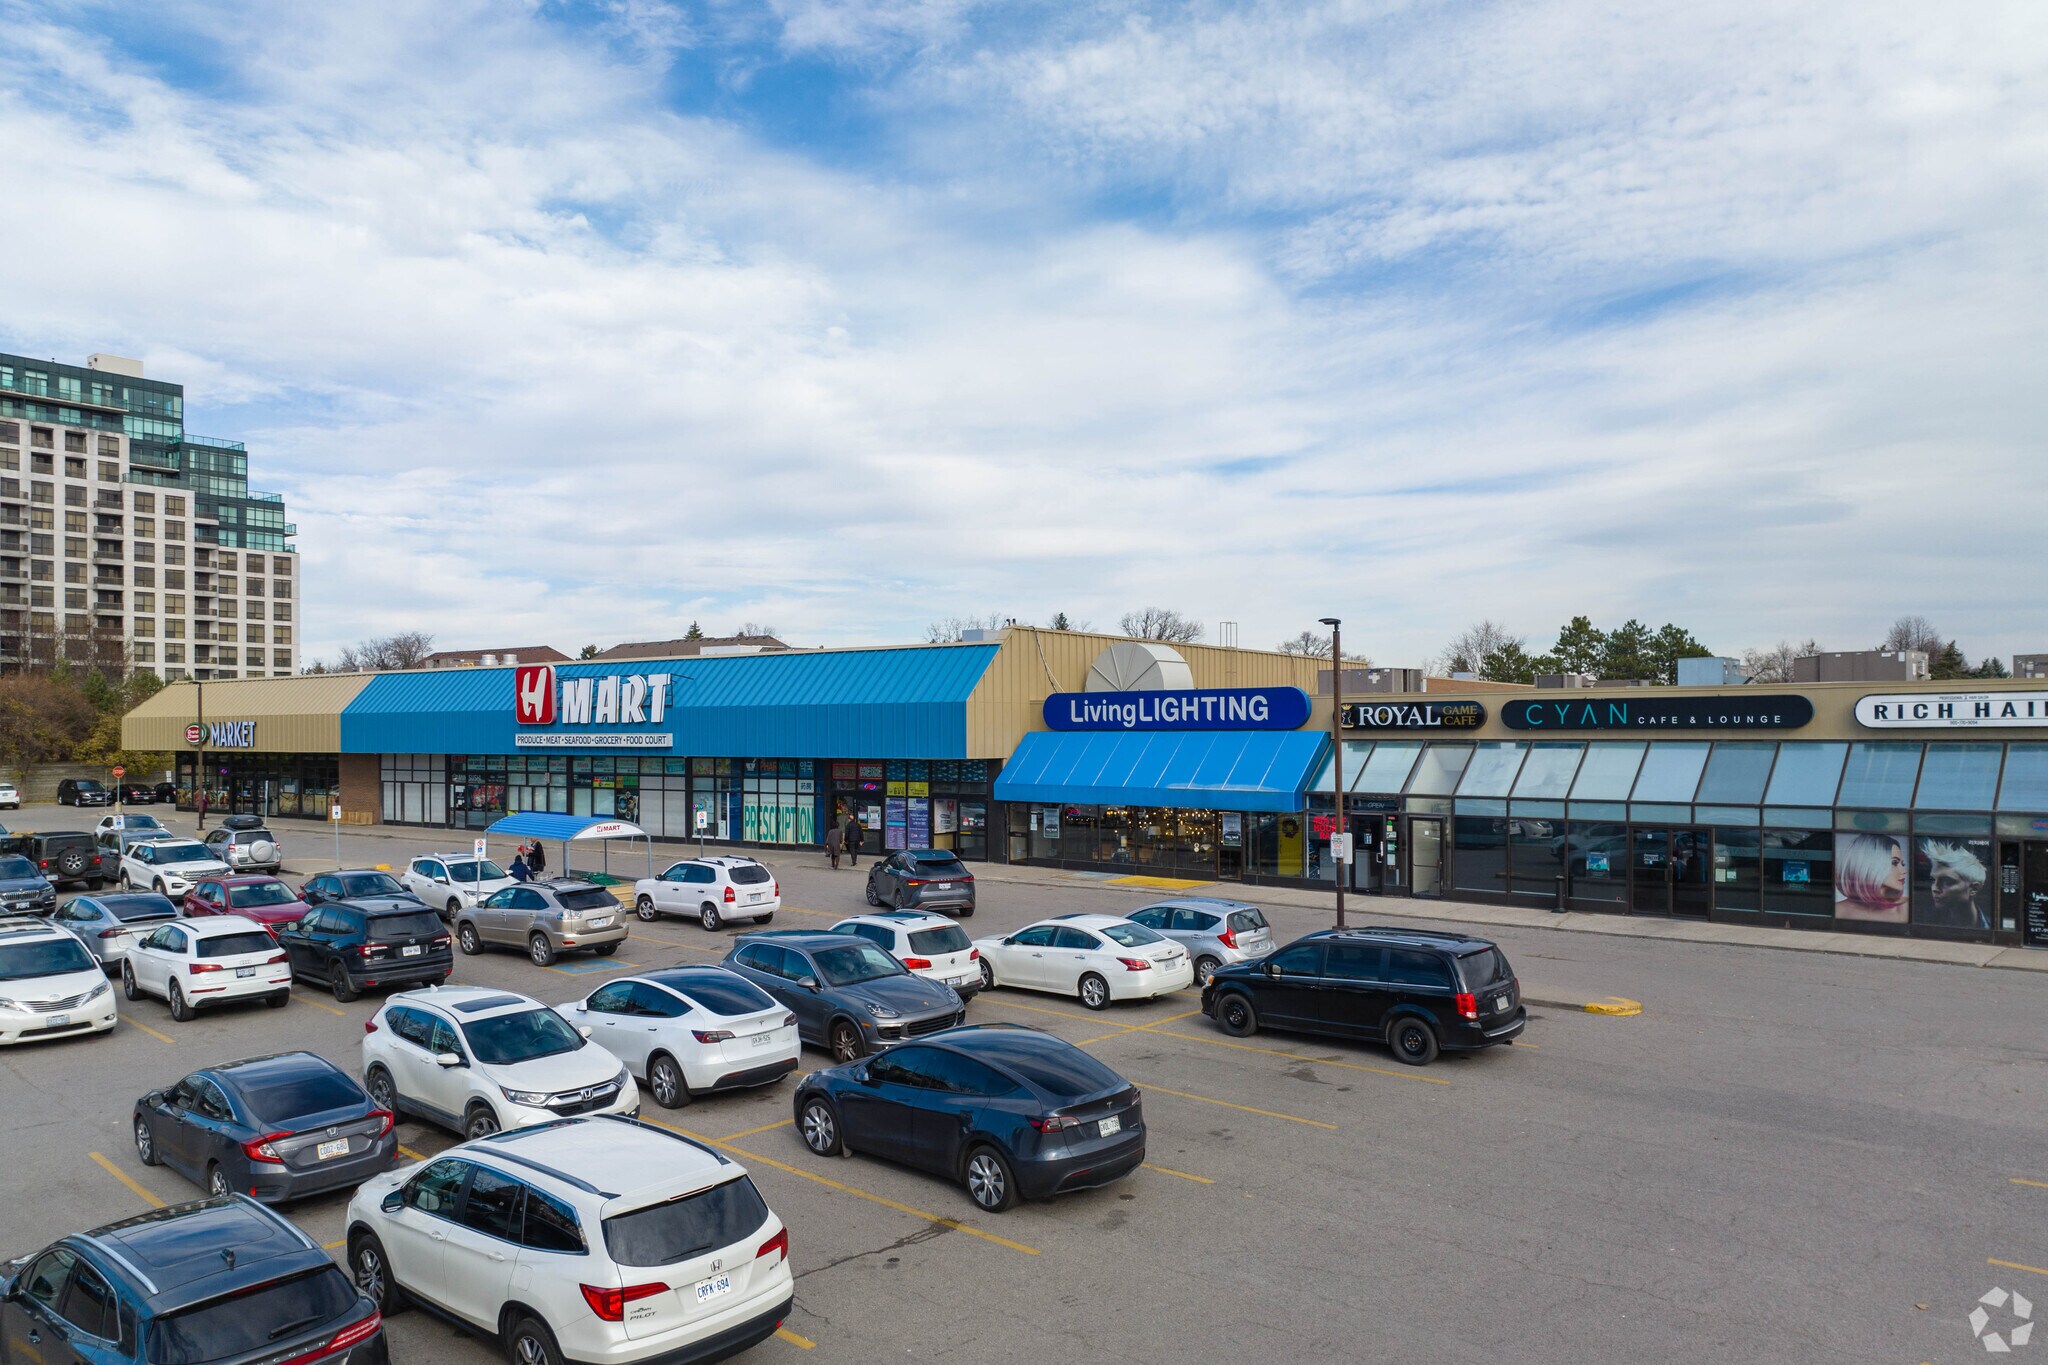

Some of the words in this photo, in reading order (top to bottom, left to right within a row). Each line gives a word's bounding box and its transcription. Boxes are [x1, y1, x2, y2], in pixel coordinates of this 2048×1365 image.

[520, 668, 547, 722] H
[562, 673, 671, 723] MART
[1358, 706, 1442, 726] ROYAL
[1443, 705, 1478, 715] GAME
[1444, 716, 1477, 725] CAFE
[1526, 703, 1628, 725] CYAN
[1638, 716, 1678, 724] CAFE
[1690, 716, 1696, 724] &
[1708, 715, 1782, 724] LOUNGE
[1874, 703, 1953, 719] RICH
[1975, 701, 2048, 718] HAI
[211, 721, 256, 747] MARKET
[517, 736, 543, 744] PRODUCE
[546, 736, 561, 744] MEAT
[564, 736, 591, 744] SEAFOOD
[594, 736, 623, 744] GROCERY
[626, 736, 643, 744] FOOD
[644, 736, 666, 744] COURT
[697, 1283, 715, 1298] CRFK
[717, 1276, 730, 1291] 694
[629, 1311, 657, 1321] PILOT
